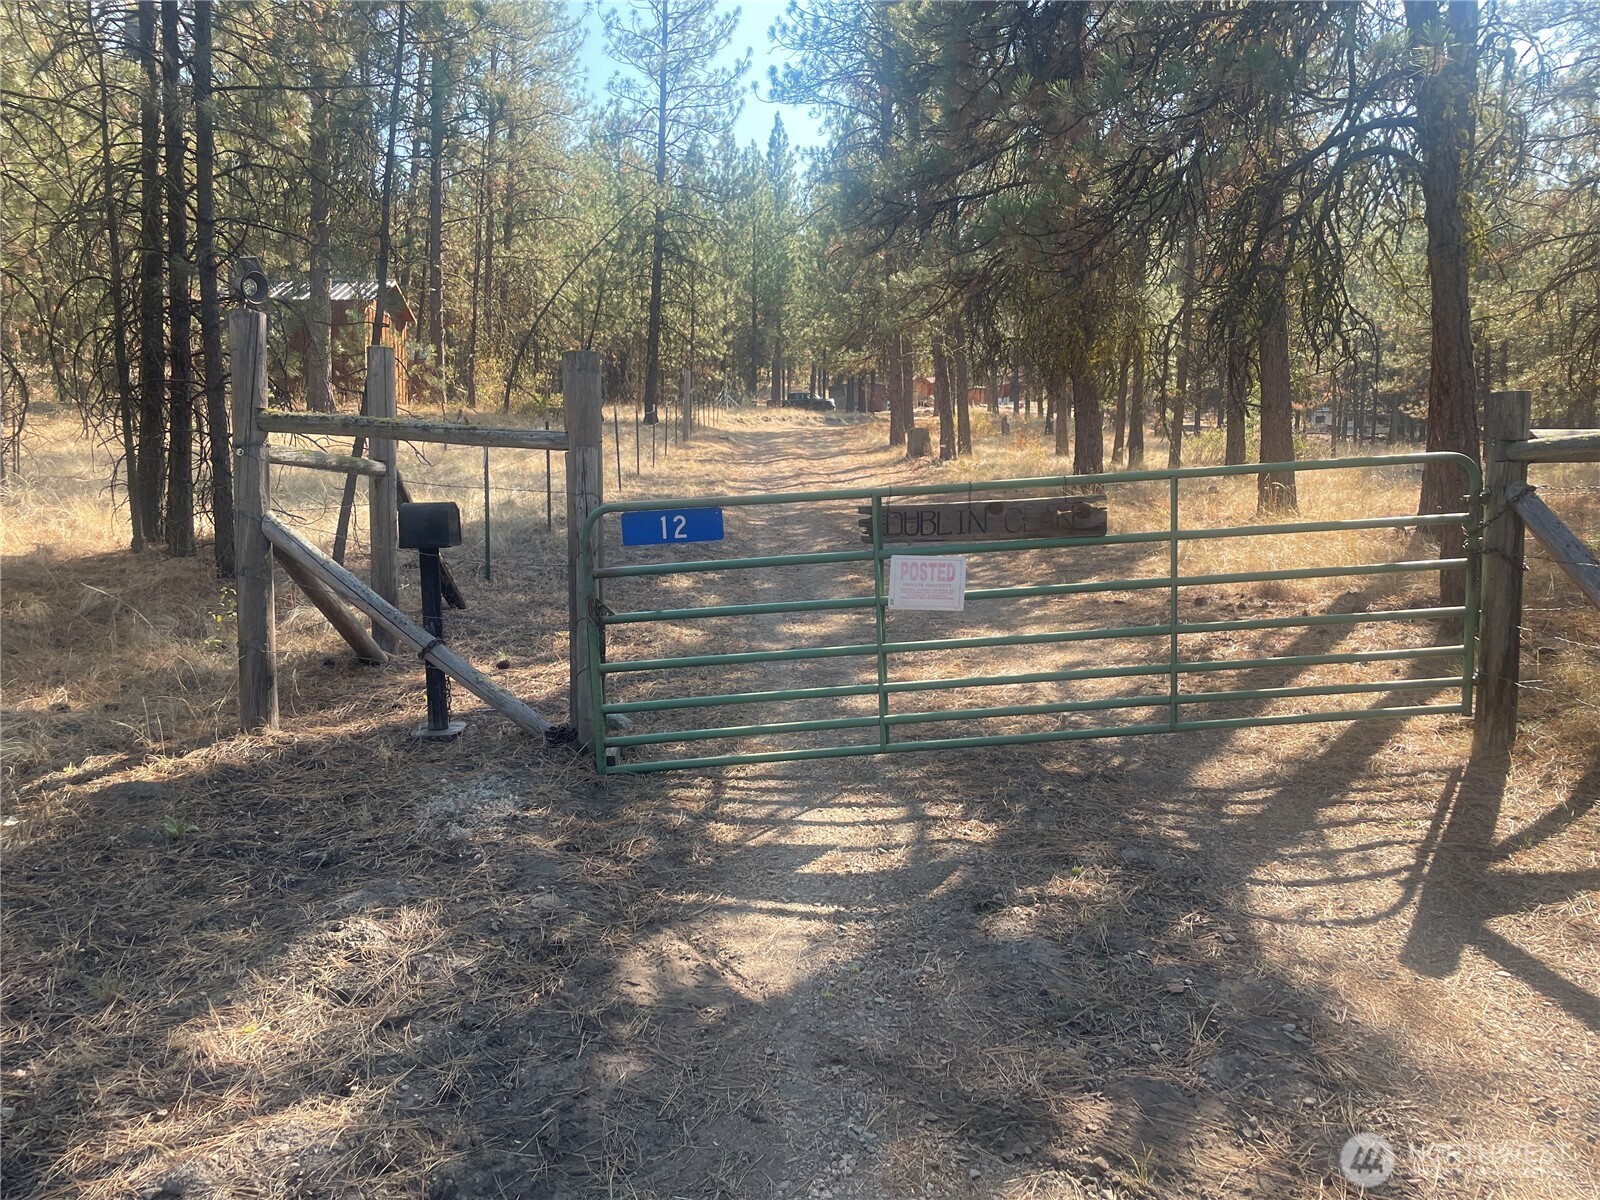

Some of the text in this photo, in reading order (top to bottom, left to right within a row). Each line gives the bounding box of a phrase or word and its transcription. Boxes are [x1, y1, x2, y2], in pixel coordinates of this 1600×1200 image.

[660, 514, 688, 540] 12
[886, 507, 988, 536] DUBLIN
[900, 561, 956, 582] POSTED
